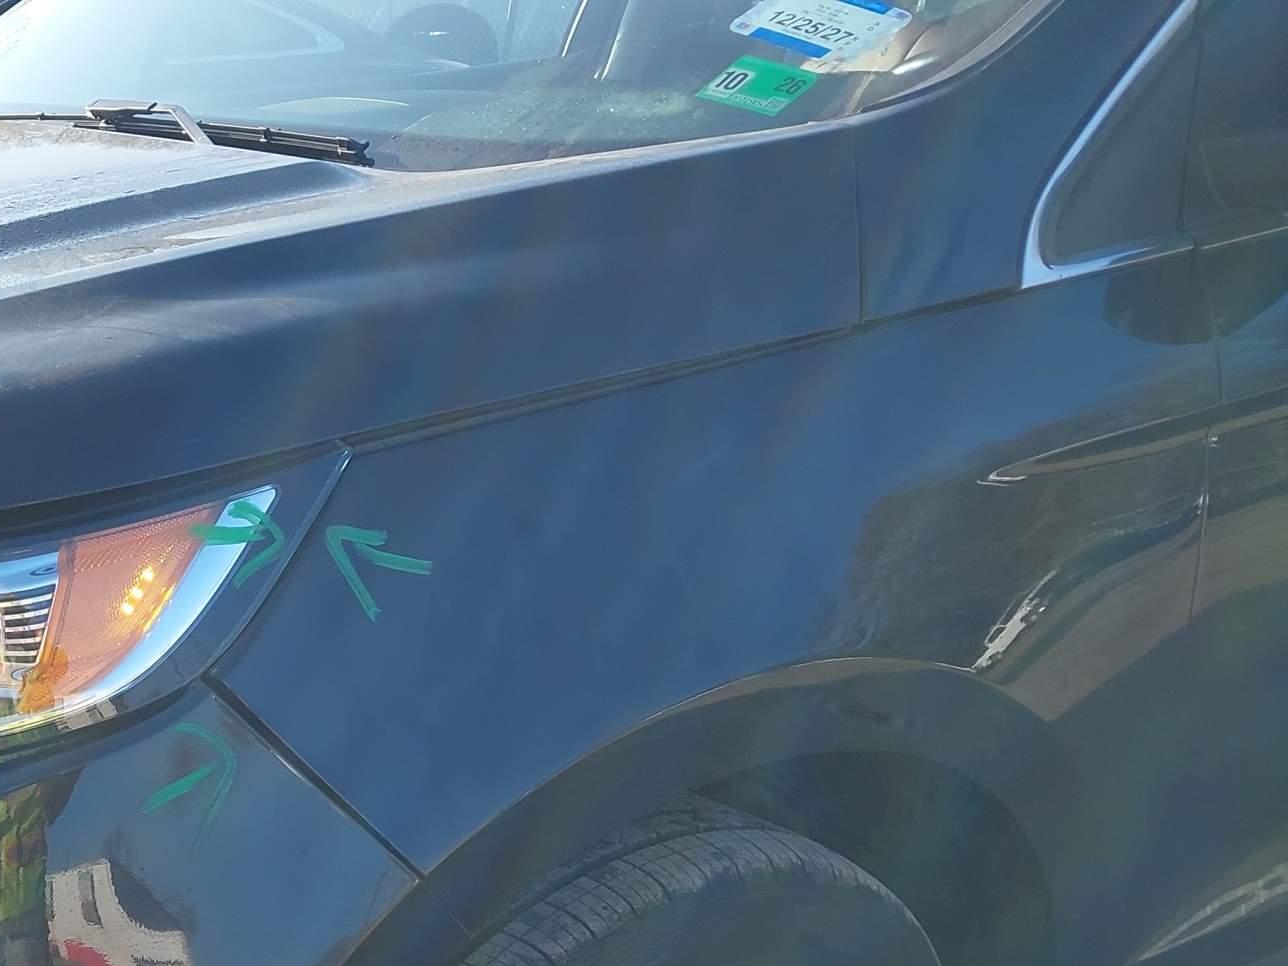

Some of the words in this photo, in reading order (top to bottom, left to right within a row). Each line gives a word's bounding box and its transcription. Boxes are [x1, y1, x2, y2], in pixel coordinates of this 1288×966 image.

[768, 10, 856, 43] 12/25/27
[715, 70, 749, 90] 10
[773, 76, 808, 94] 26
